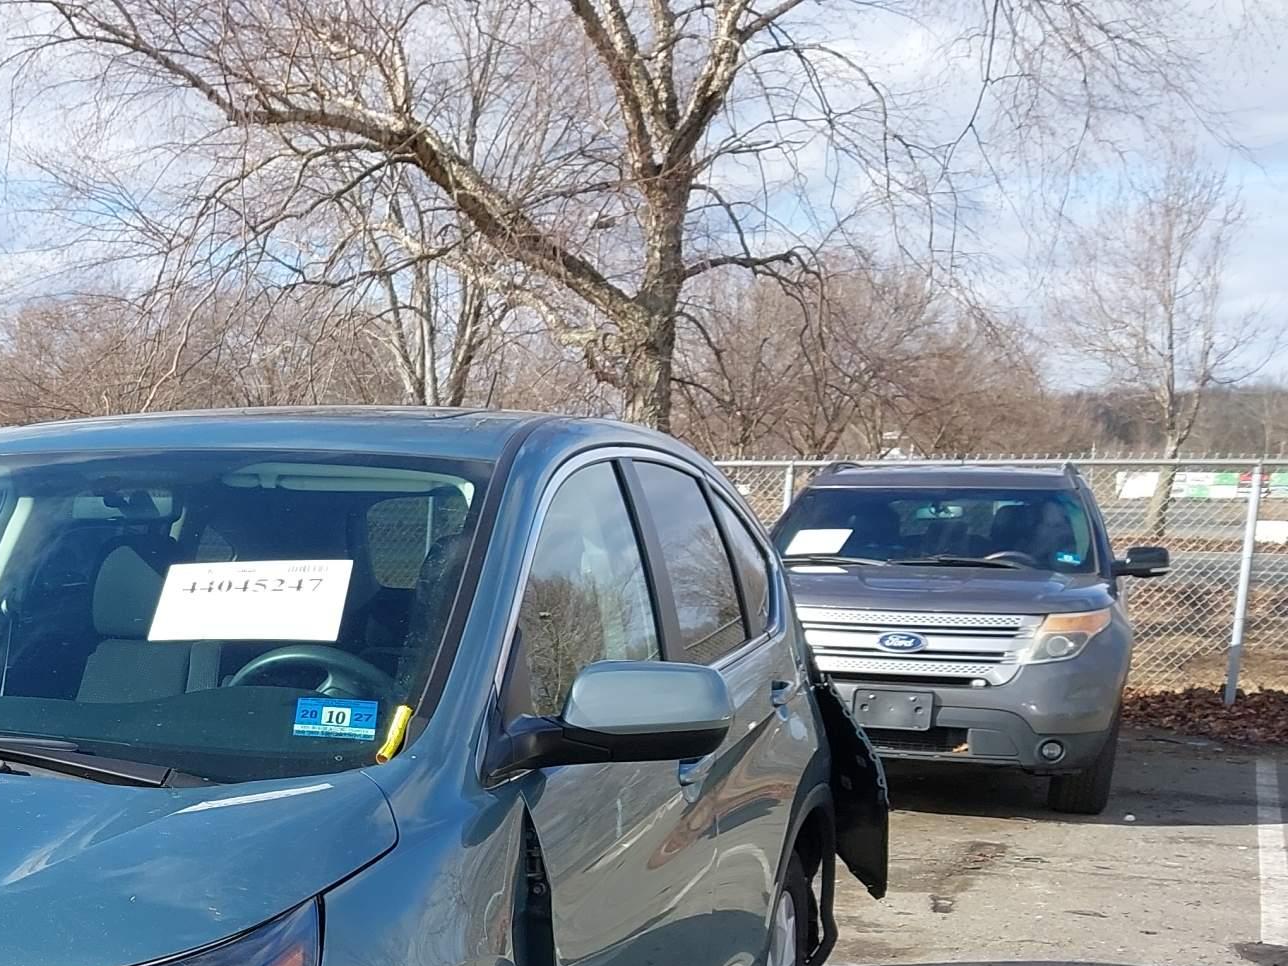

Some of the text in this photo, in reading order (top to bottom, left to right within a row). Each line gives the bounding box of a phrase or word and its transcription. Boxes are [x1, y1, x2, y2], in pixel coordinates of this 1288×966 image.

[182, 578, 324, 594] 44045247
[884, 634, 916, 647] Ford
[300, 709, 374, 725] 20 10 27
